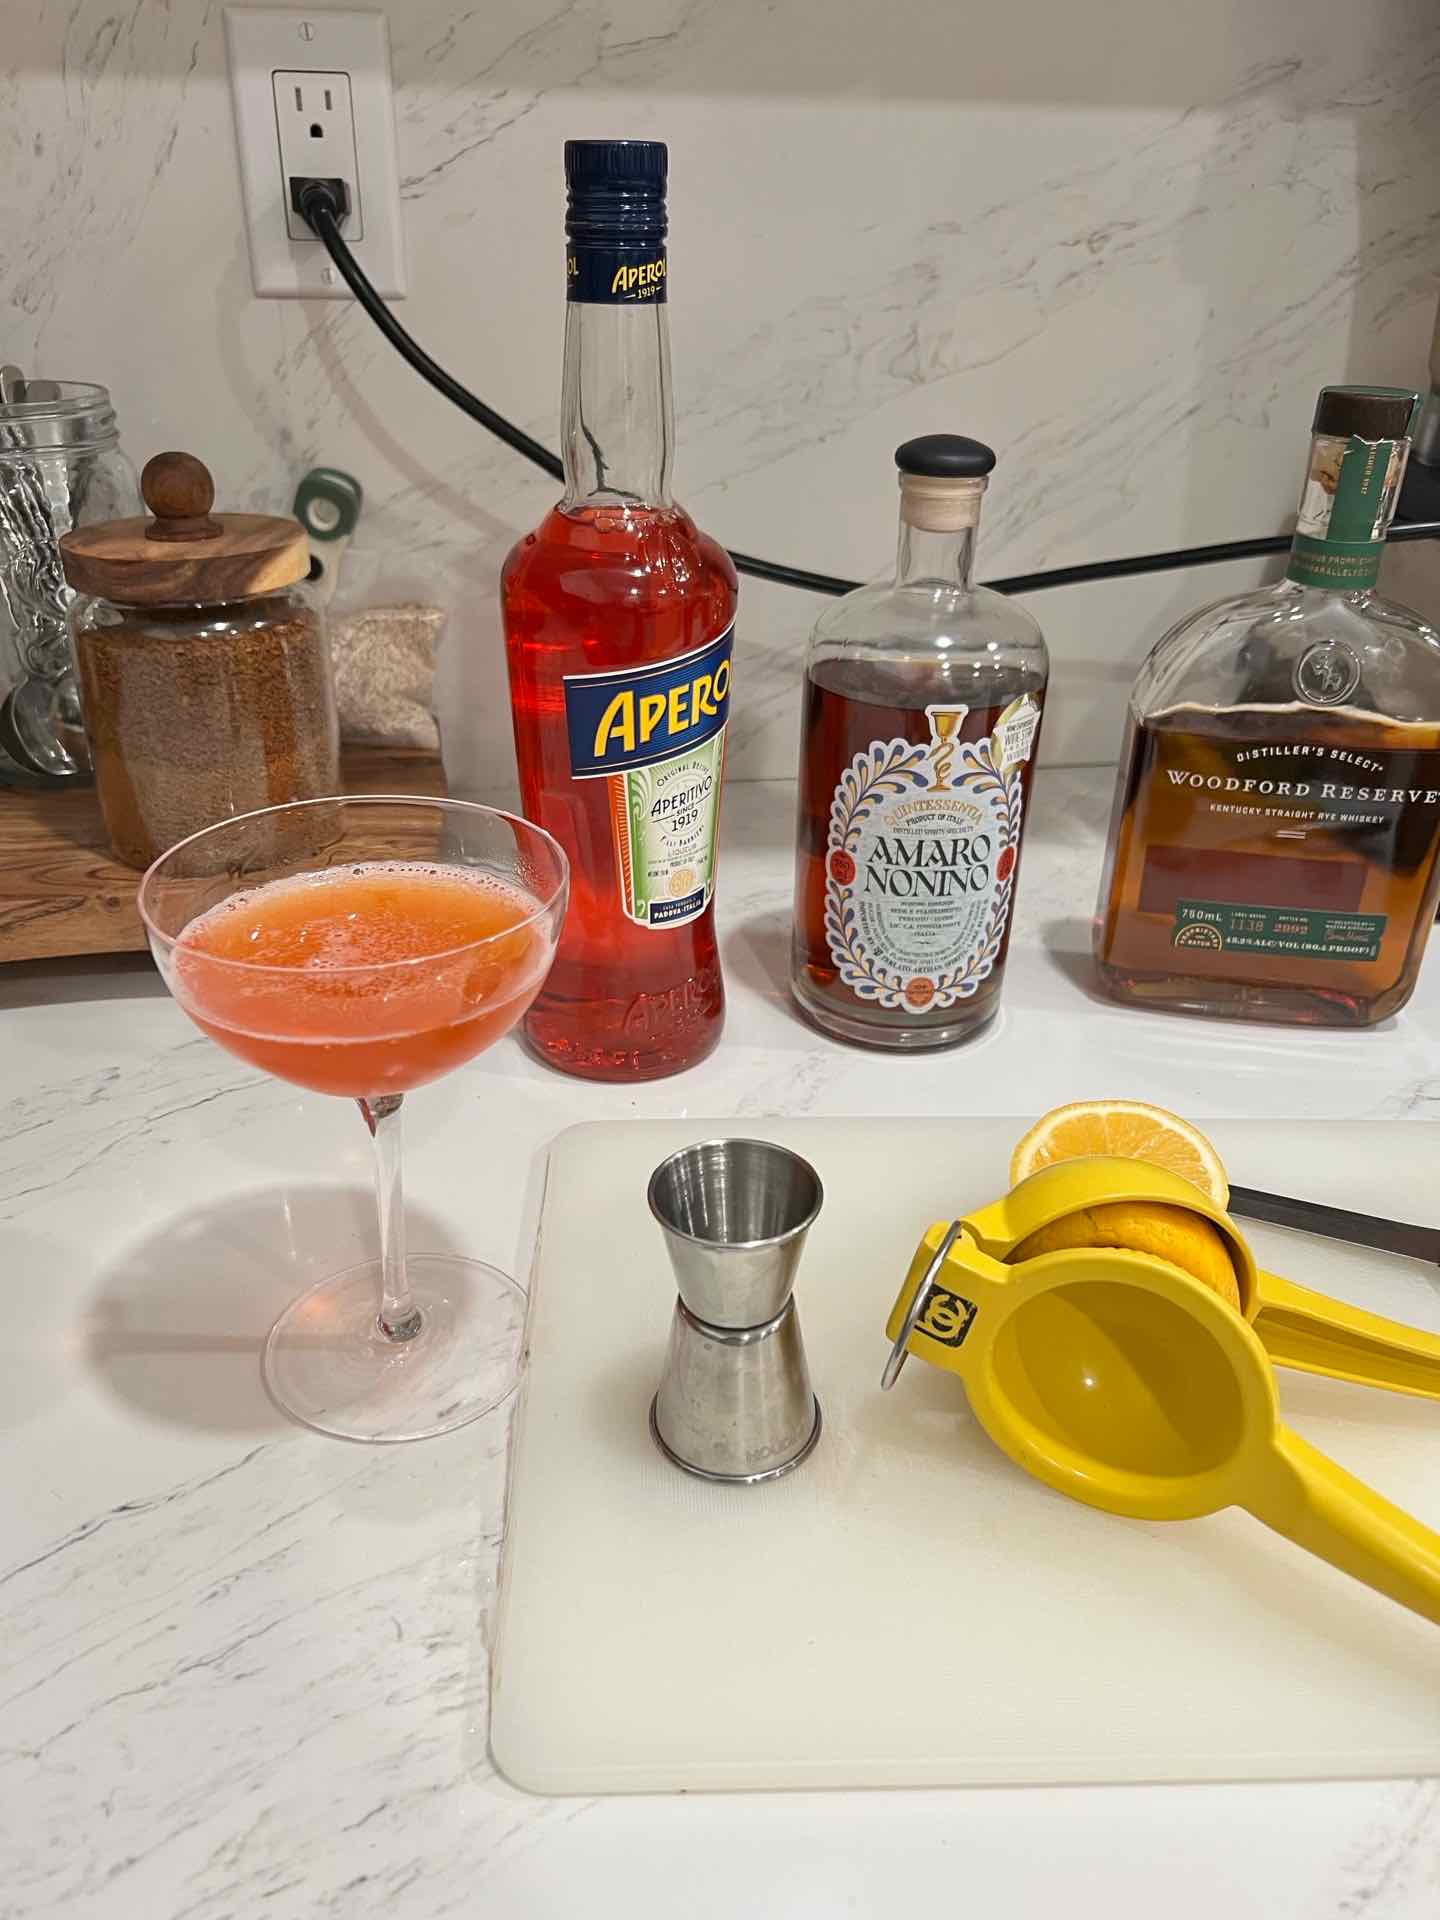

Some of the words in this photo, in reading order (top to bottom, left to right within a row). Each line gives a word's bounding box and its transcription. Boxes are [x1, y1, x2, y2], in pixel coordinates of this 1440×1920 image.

[638, 286, 655, 298] 1919
[594, 659, 731, 757] APERO
[1237, 745, 1325, 762] DISTILLER'S
[1330, 750, 1379, 772] SELECT
[657, 764, 689, 786] ORIGINAL
[1167, 769, 1310, 797] WOODFORD
[1321, 783, 1438, 803] RESERVE
[651, 775, 712, 816] APERITIVO
[671, 809, 698, 832] 1919
[676, 802, 695, 816] SINCE
[905, 813, 934, 826] PRODUCT
[1209, 804, 1261, 816] KENTUCKY
[1265, 808, 1314, 819] STRAIGHT
[1318, 811, 1336, 821] RYE
[1340, 813, 1384, 824] WHISKEY
[867, 834, 991, 867] AMARO
[864, 864, 989, 897] NONINO
[1182, 908, 1223, 922] 750mL
